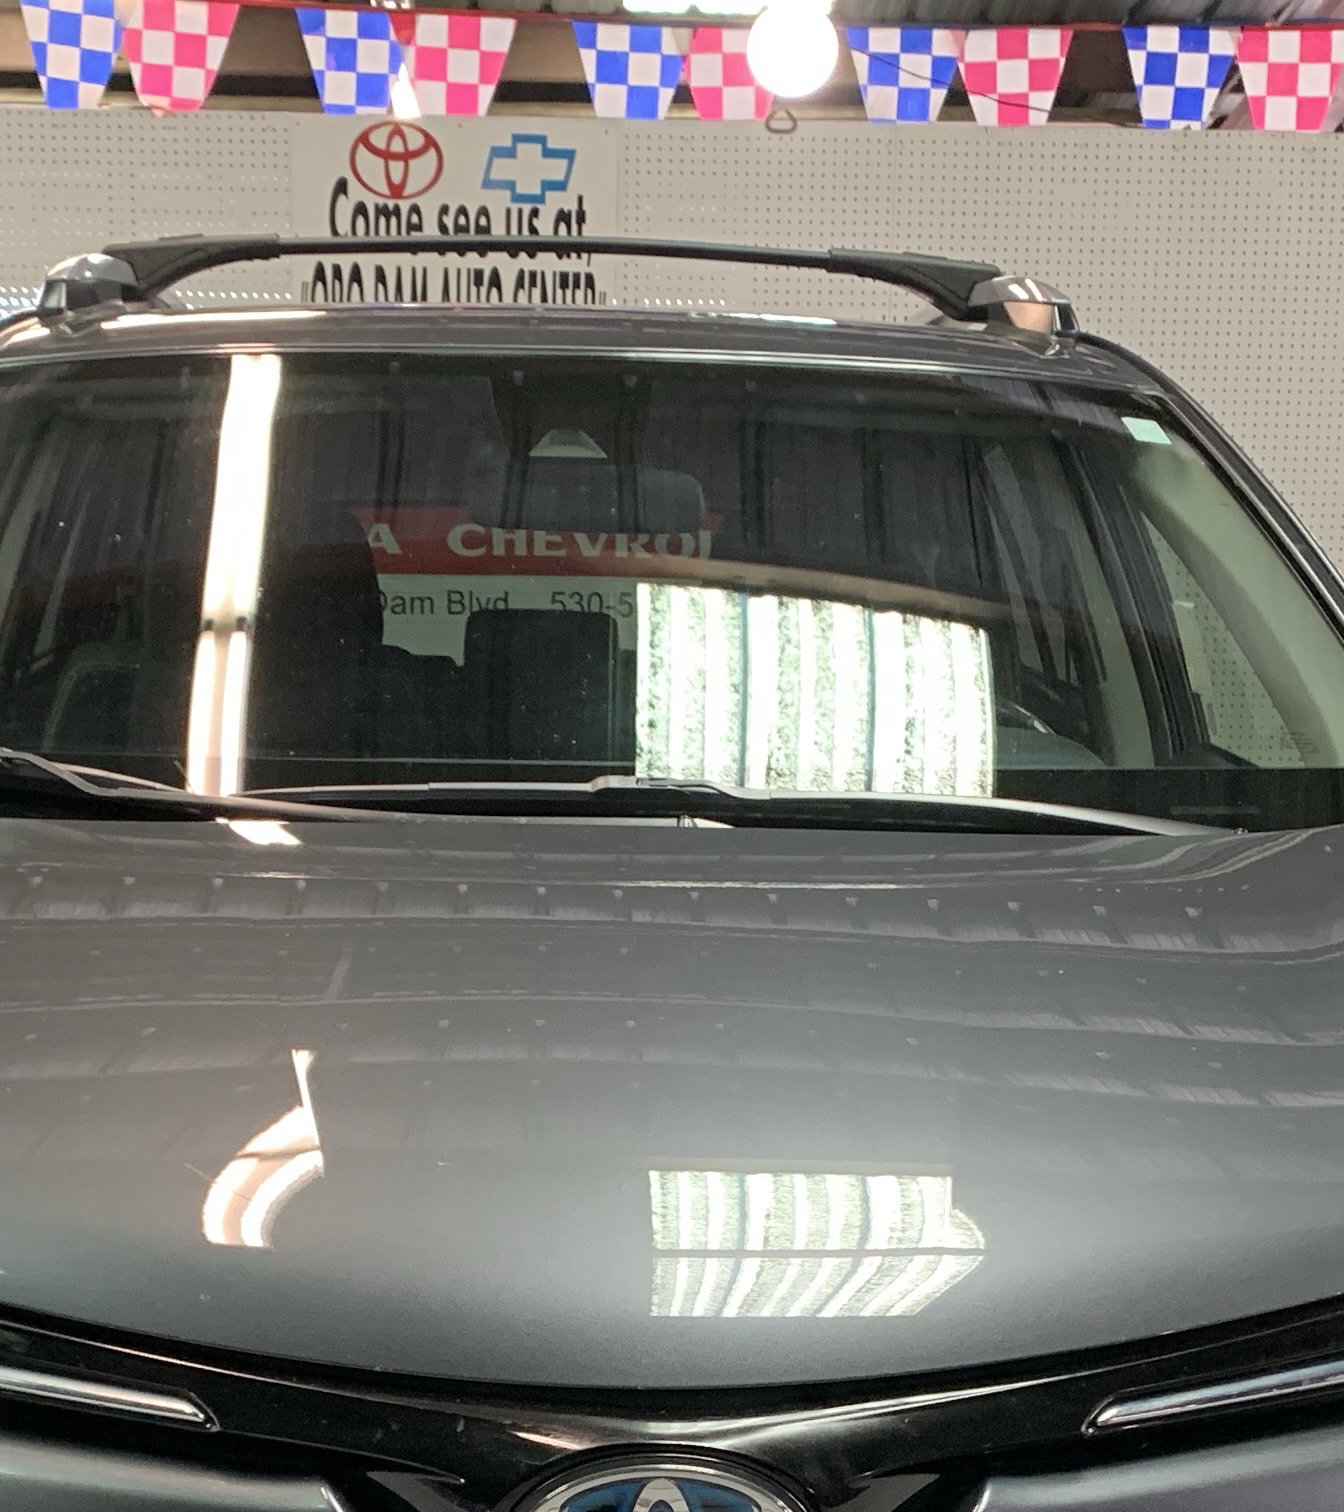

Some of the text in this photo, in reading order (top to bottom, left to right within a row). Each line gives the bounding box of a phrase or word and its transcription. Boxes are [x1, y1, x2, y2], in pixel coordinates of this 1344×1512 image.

[329, 176, 423, 254] Come
[437, 203, 492, 257] see
[506, 205, 540, 258] us
